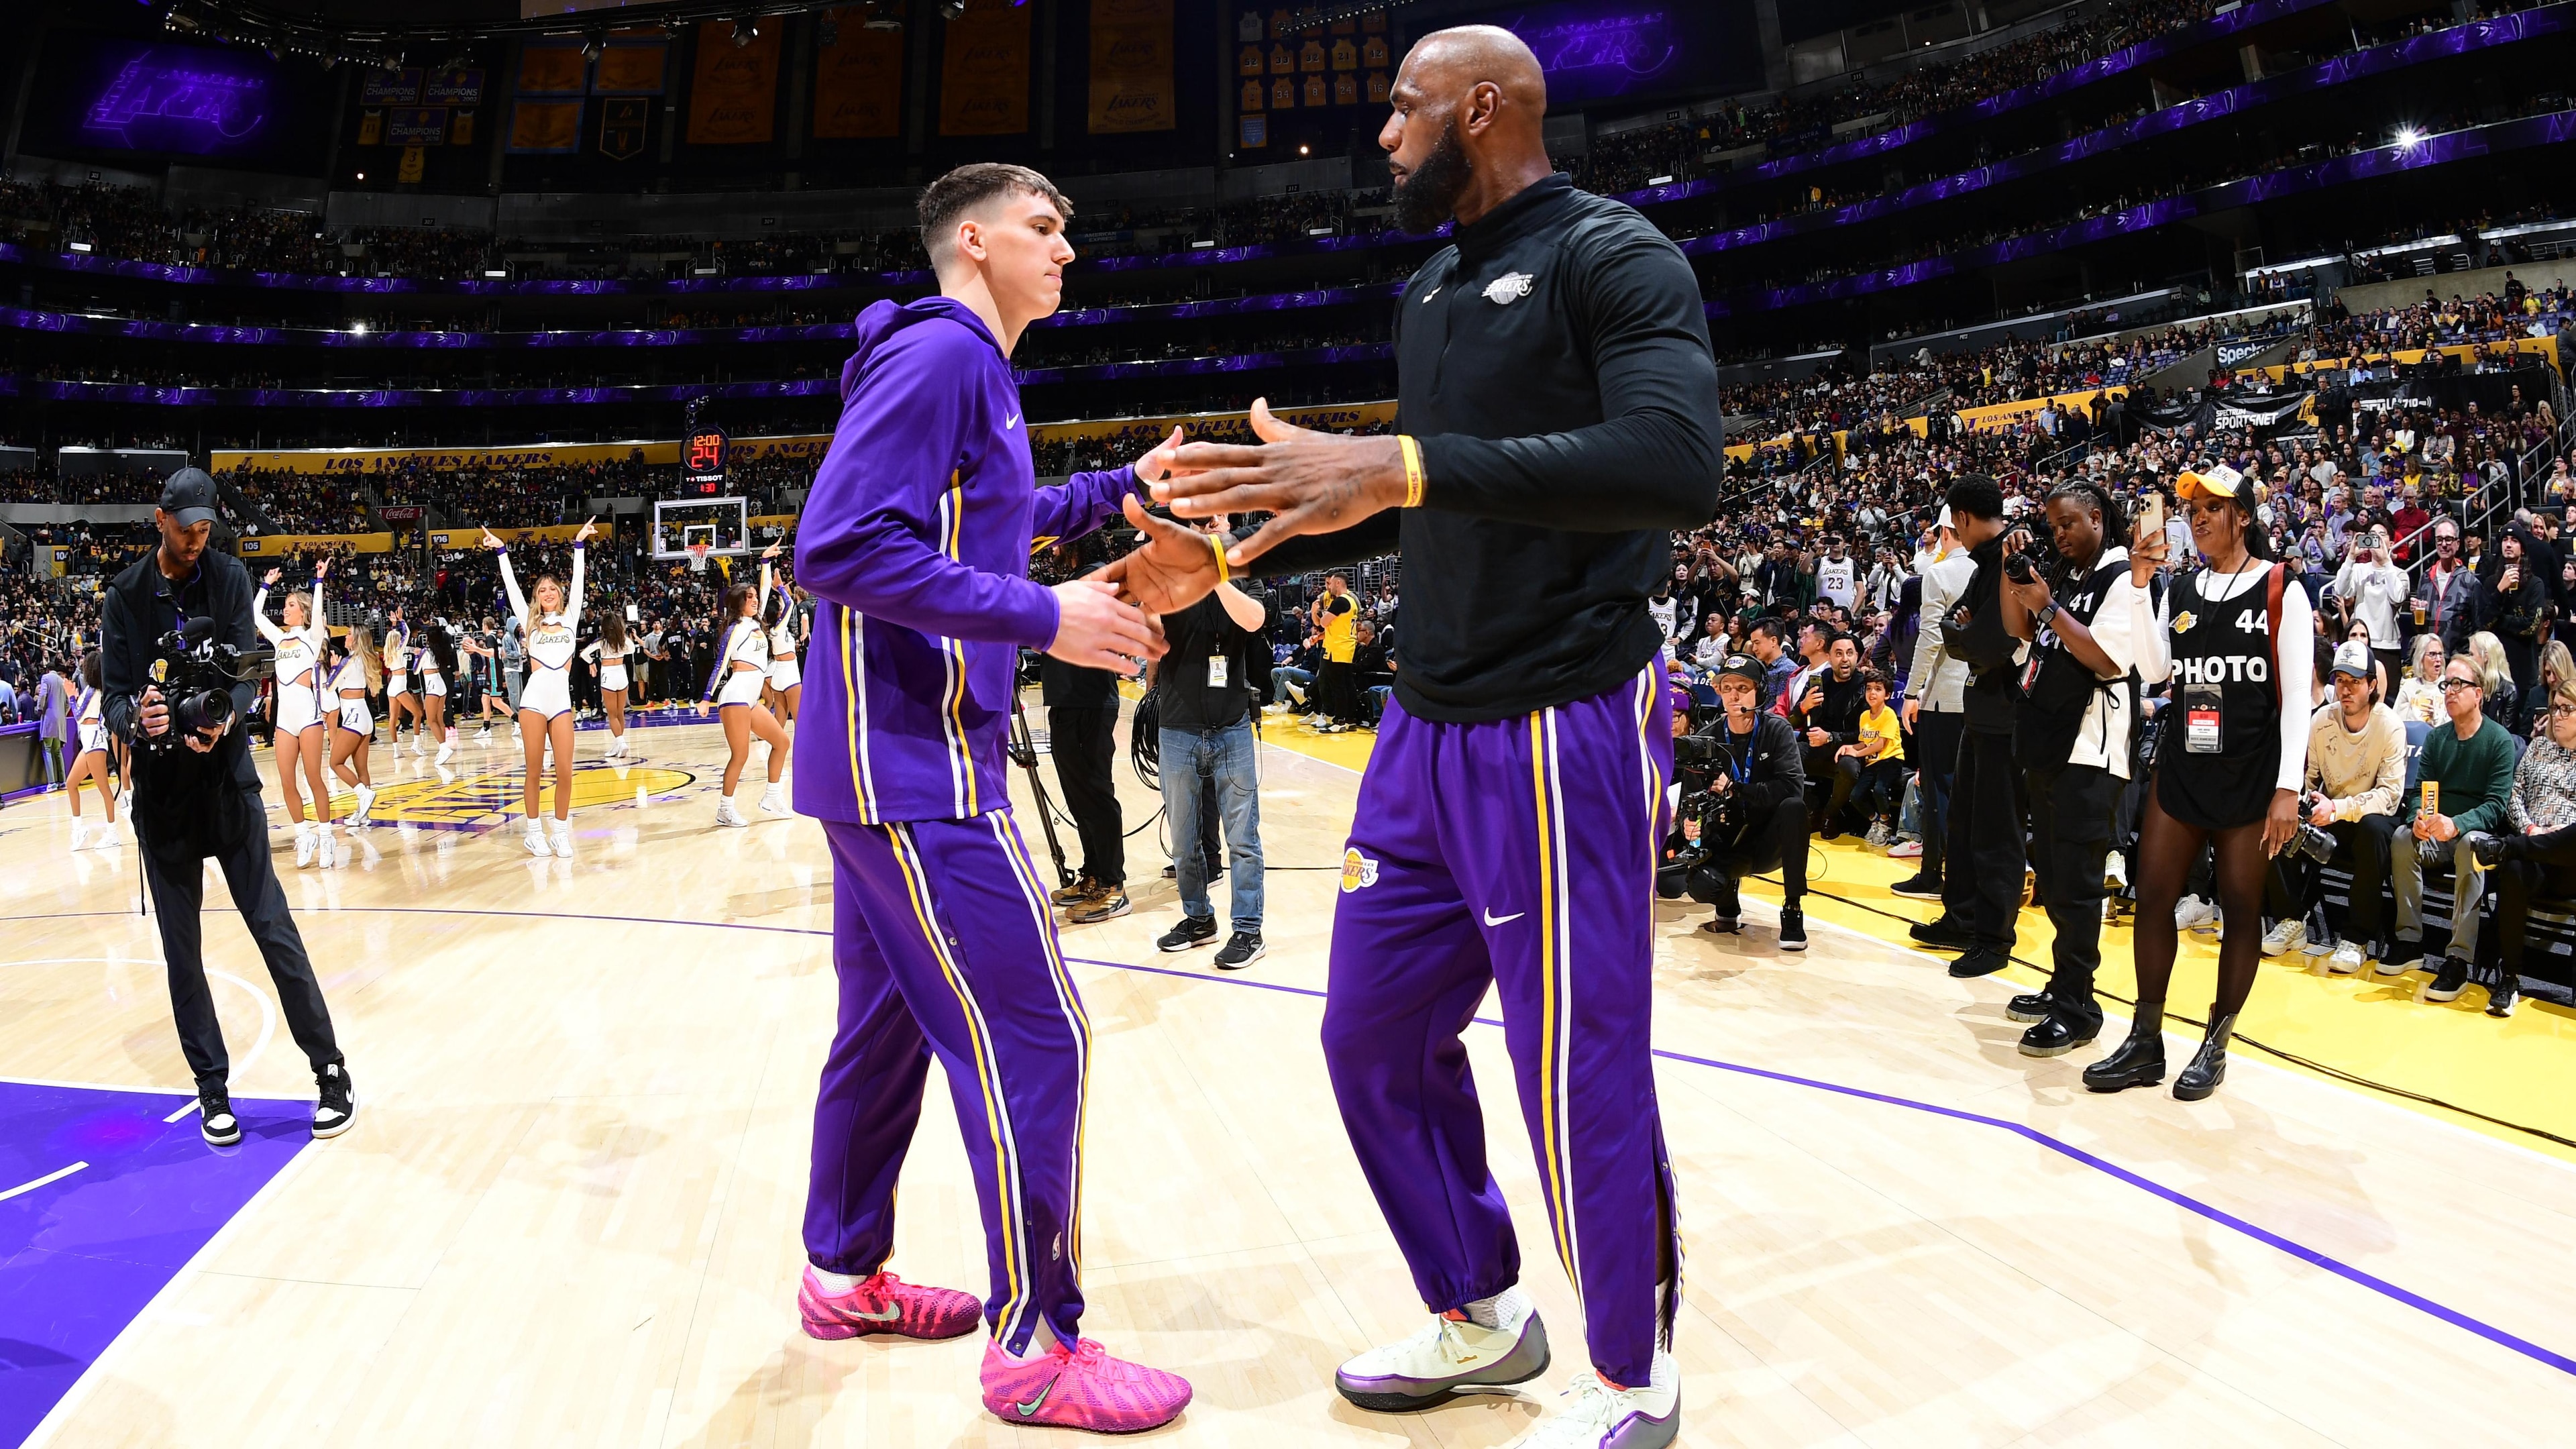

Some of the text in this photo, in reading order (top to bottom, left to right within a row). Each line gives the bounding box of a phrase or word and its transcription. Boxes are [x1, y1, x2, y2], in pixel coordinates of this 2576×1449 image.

[1276, 56, 1289, 65] 33
[1305, 54, 1319, 63] 32
[1338, 52, 1349, 61] 21
[366, 88, 416, 96] CHAMPIONS
[428, 88, 478, 97] CHAMPIONS
[390, 127, 441, 136] CHAMPIONS
[409, 151, 417, 162] 3
[1481, 278, 1533, 297] LAKERS
[2217, 342, 2277, 365] Spect
[2216, 408, 2247, 417] SPECTRUM
[1982, 414, 1998, 423] LOS
[2215, 412, 2279, 430] SPORTSNET
[1121, 424, 1162, 435] LOS
[694, 434, 720, 447] 12:00
[730, 441, 831, 455] OS ANGEL
[325, 457, 365, 470] LOS
[468, 452, 553, 466] LAKERS
[691, 446, 718, 468] 24
[696, 474, 723, 482] TISSOT
[432, 535, 447, 543] 106
[244, 541, 258, 551] 105
[1823, 568, 1849, 576] LAKERS
[1828, 578, 1843, 590] 23
[2069, 591, 2094, 612] 41
[2235, 609, 2269, 635] 44
[536, 634, 570, 645] LAKERS
[2171, 655, 2267, 684] PHOTO
[1343, 864, 1375, 883] AKERS
